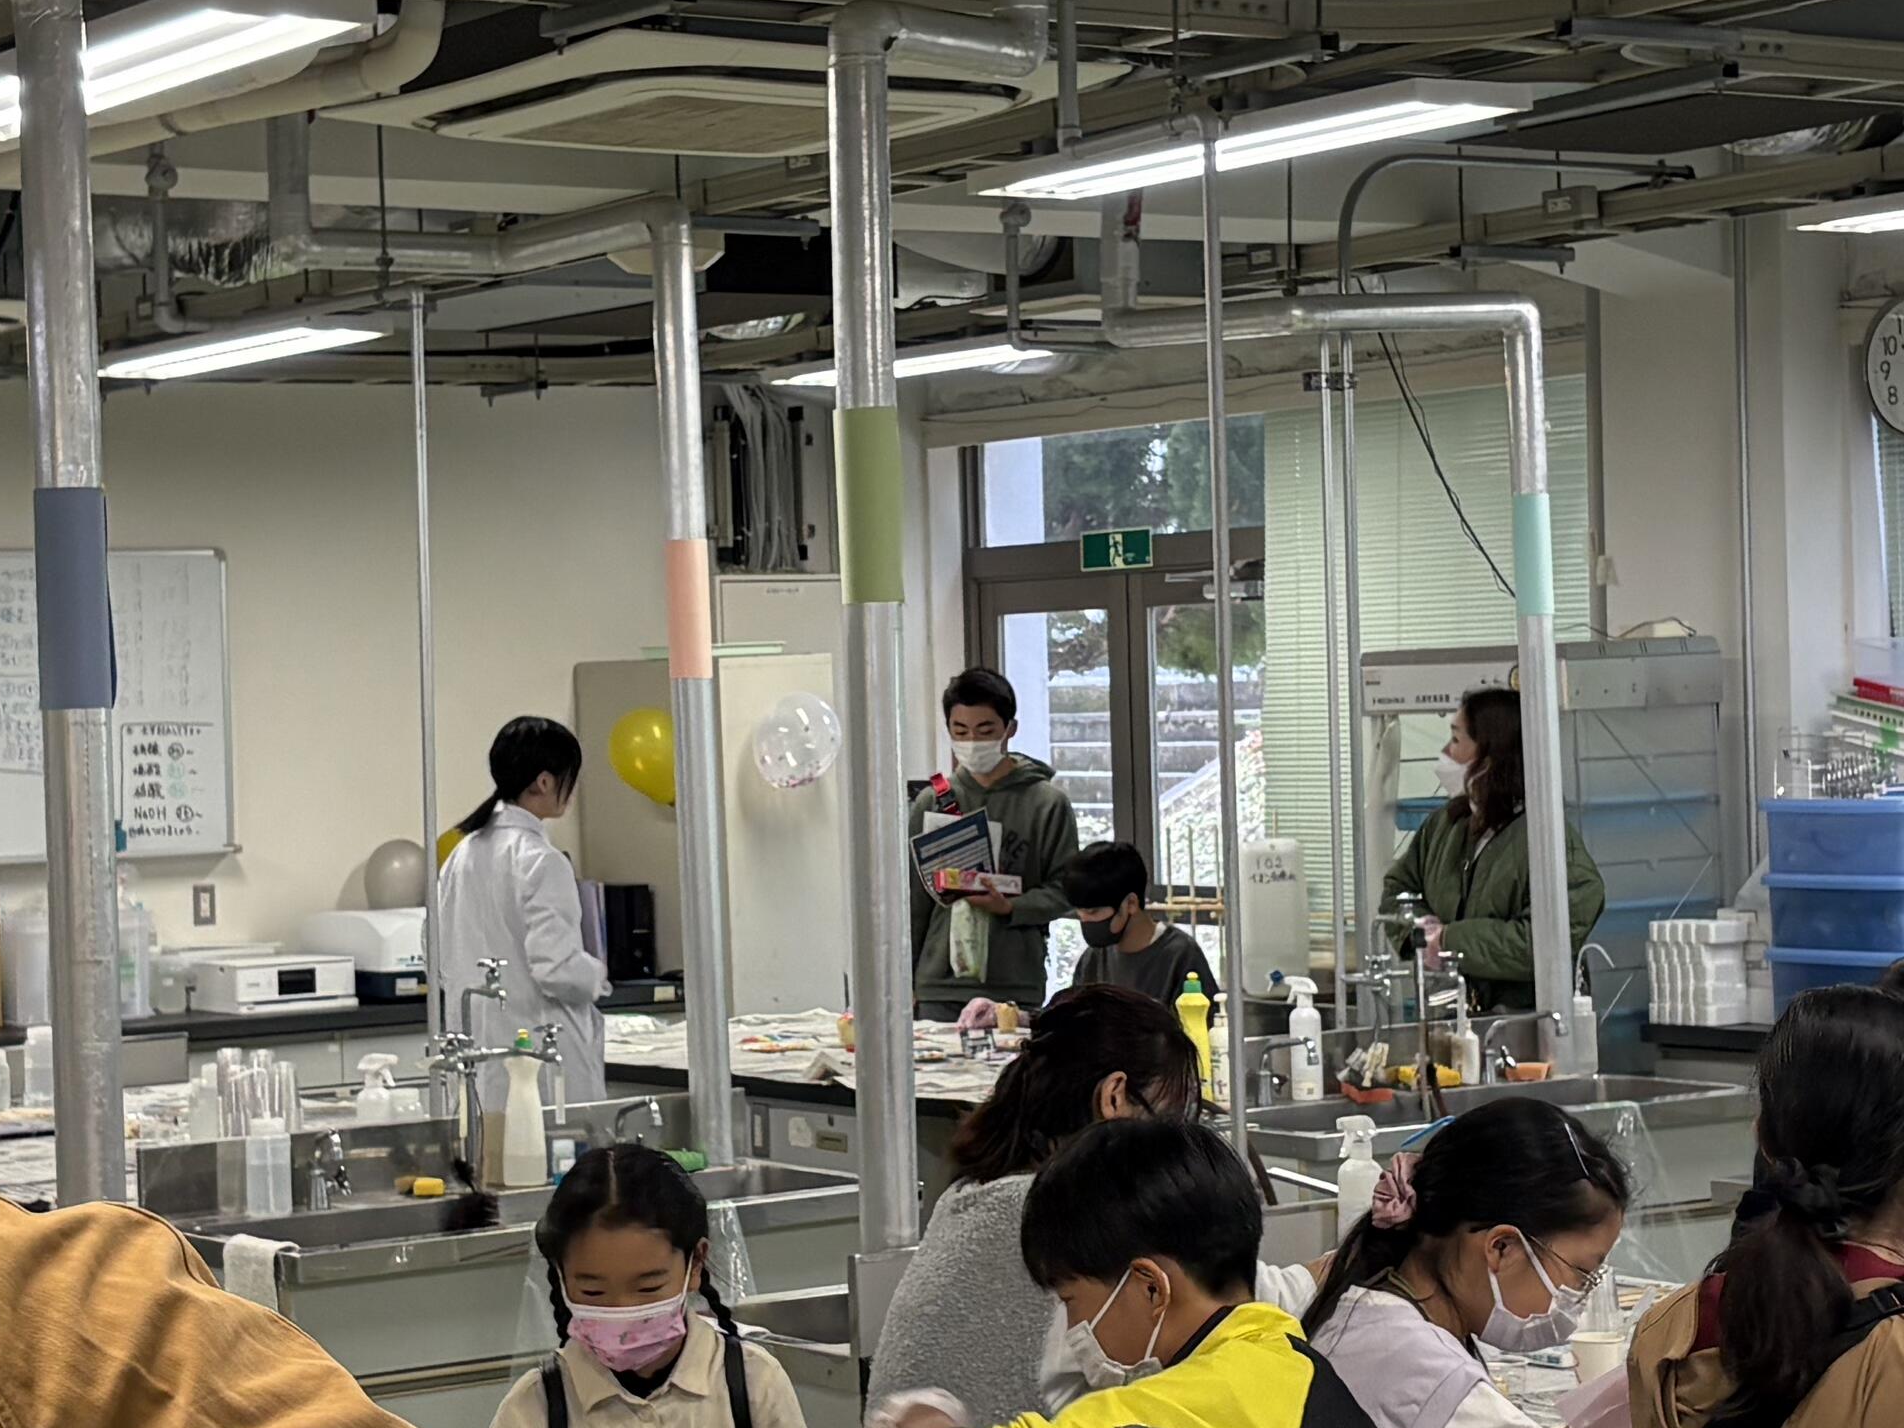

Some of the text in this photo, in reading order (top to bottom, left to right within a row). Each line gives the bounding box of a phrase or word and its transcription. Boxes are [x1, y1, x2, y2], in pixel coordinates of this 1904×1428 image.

[1882, 336, 1897, 356] 10
[1880, 361, 1890, 380] 9
[1888, 386, 1898, 405] 8
